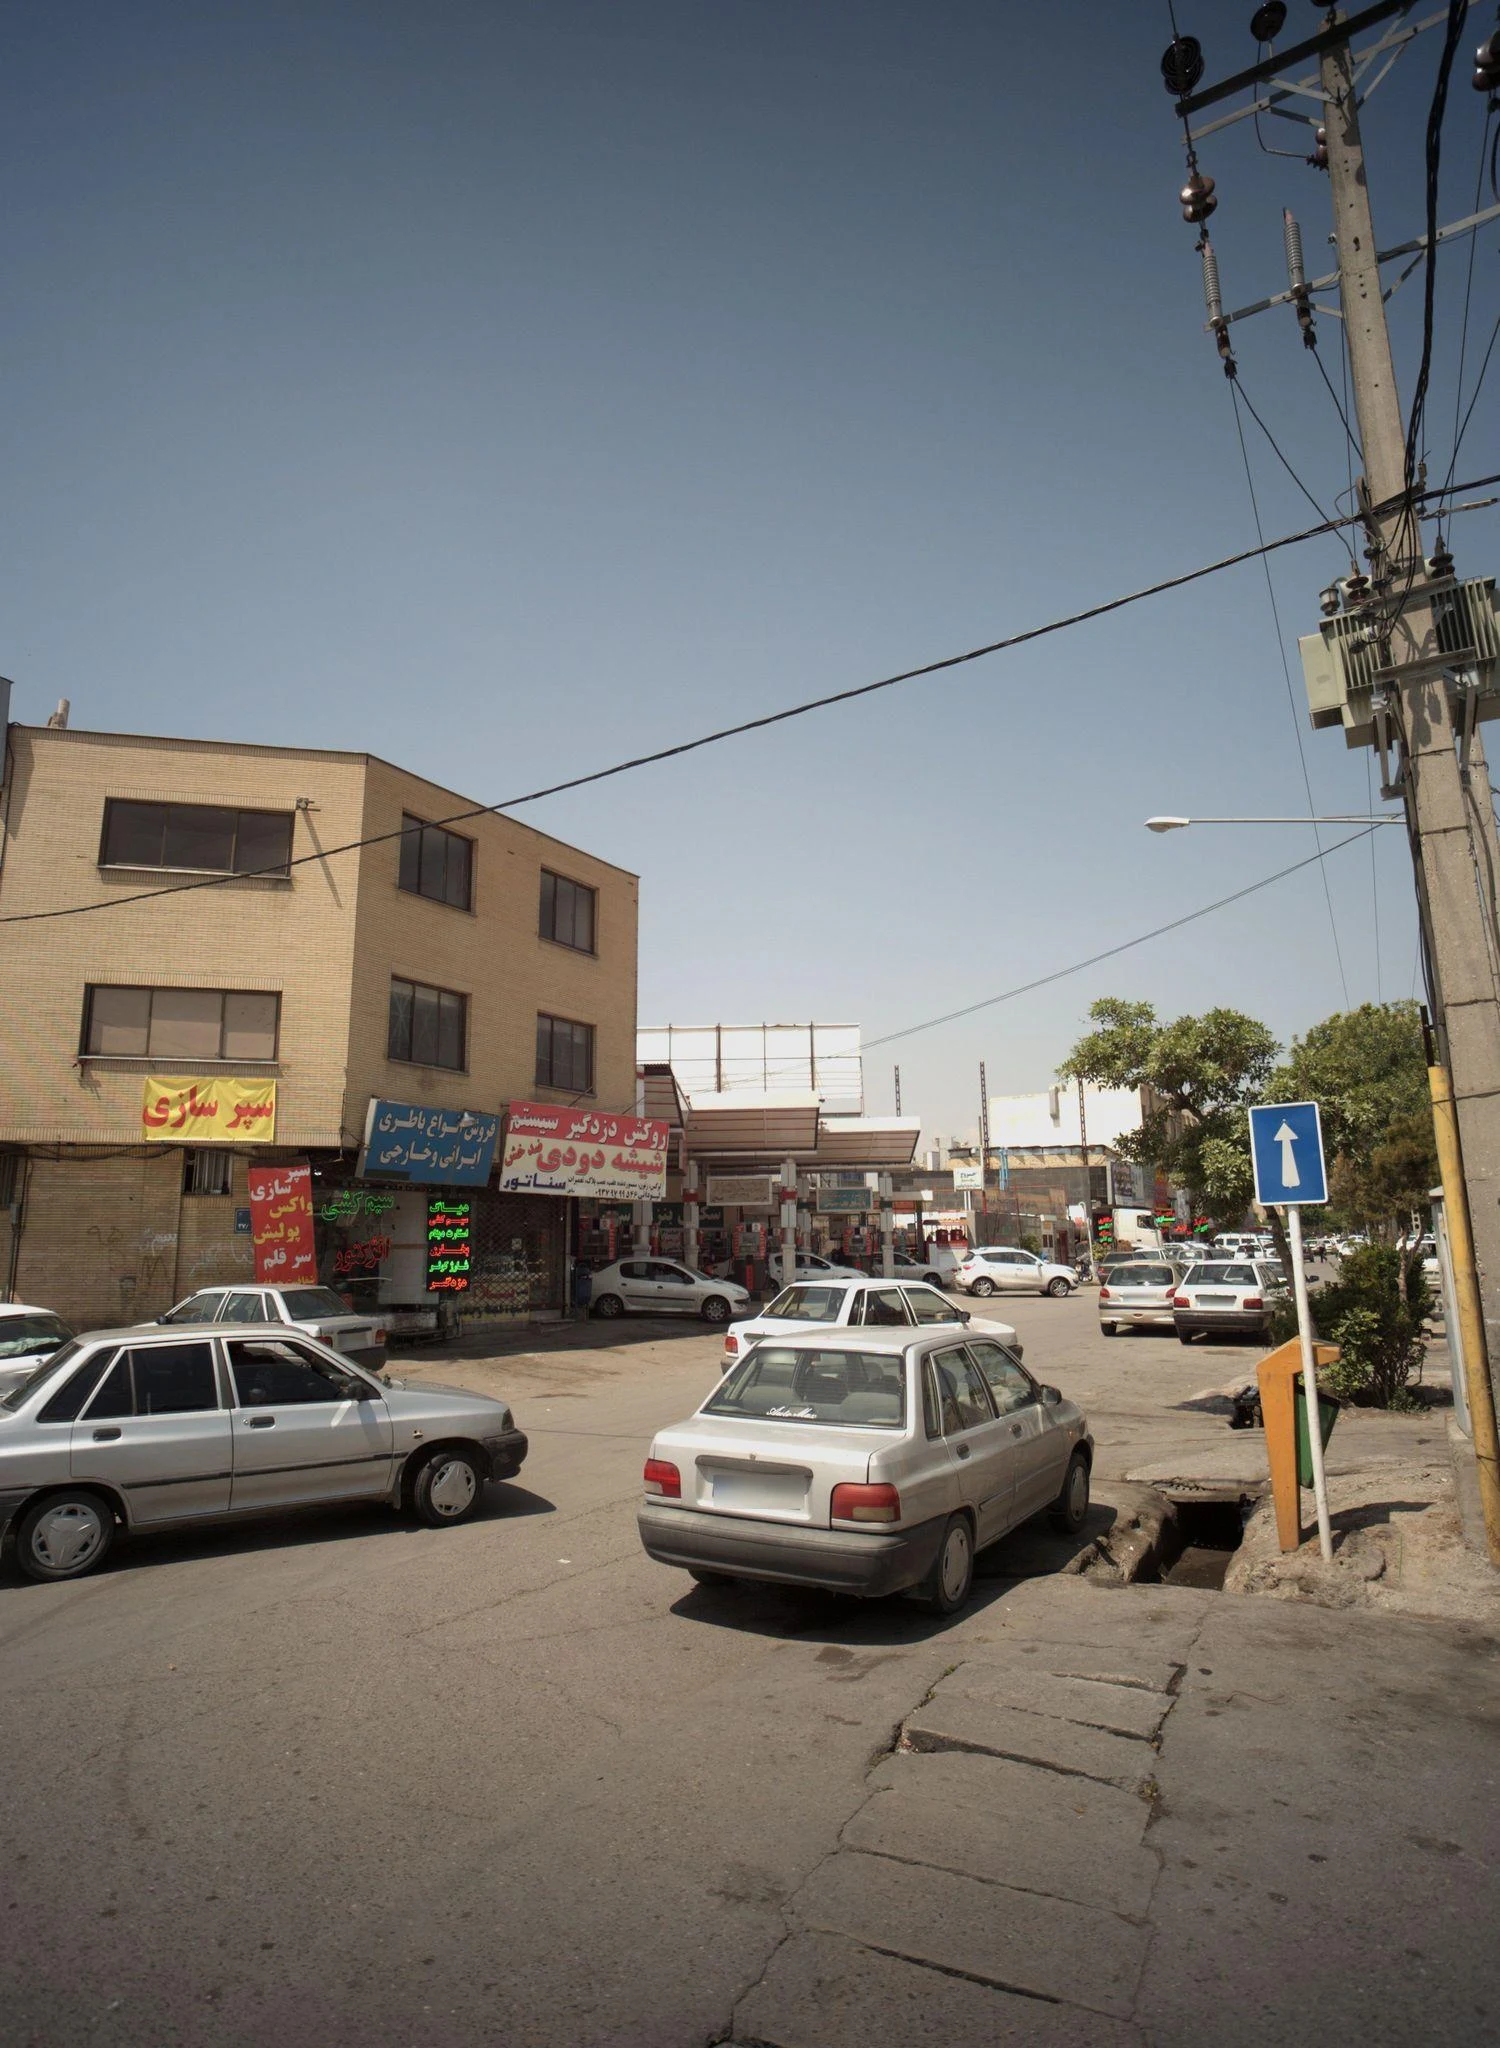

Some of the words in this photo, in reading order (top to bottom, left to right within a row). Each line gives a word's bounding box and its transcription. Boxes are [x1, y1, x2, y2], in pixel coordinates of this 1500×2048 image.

[142, 1084, 219, 1128] سازی
[225, 1099, 274, 1130] سپر
[378, 1109, 426, 1135] باطری
[464, 1117, 496, 1143] فروش
[509, 1107, 559, 1135] سیستم
[565, 1114, 618, 1144] دزدگیر
[623, 1120, 667, 1151] روکش
[439, 1144, 482, 1170] ایرانی
[536, 1144, 606, 1176] دودی
[611, 1147, 665, 1180] شیشه
[285, 1166, 311, 1183] سپر
[503, 1172, 567, 1191] سناتور
[250, 1178, 291, 1202] سازی
[269, 1195, 313, 1219] واکس
[320, 1190, 364, 1221] کشی
[364, 1195, 395, 1216] سیم
[253, 1221, 301, 1245] پولیش
[263, 1246, 287, 1271] قلم
[291, 1252, 312, 1269] سر
